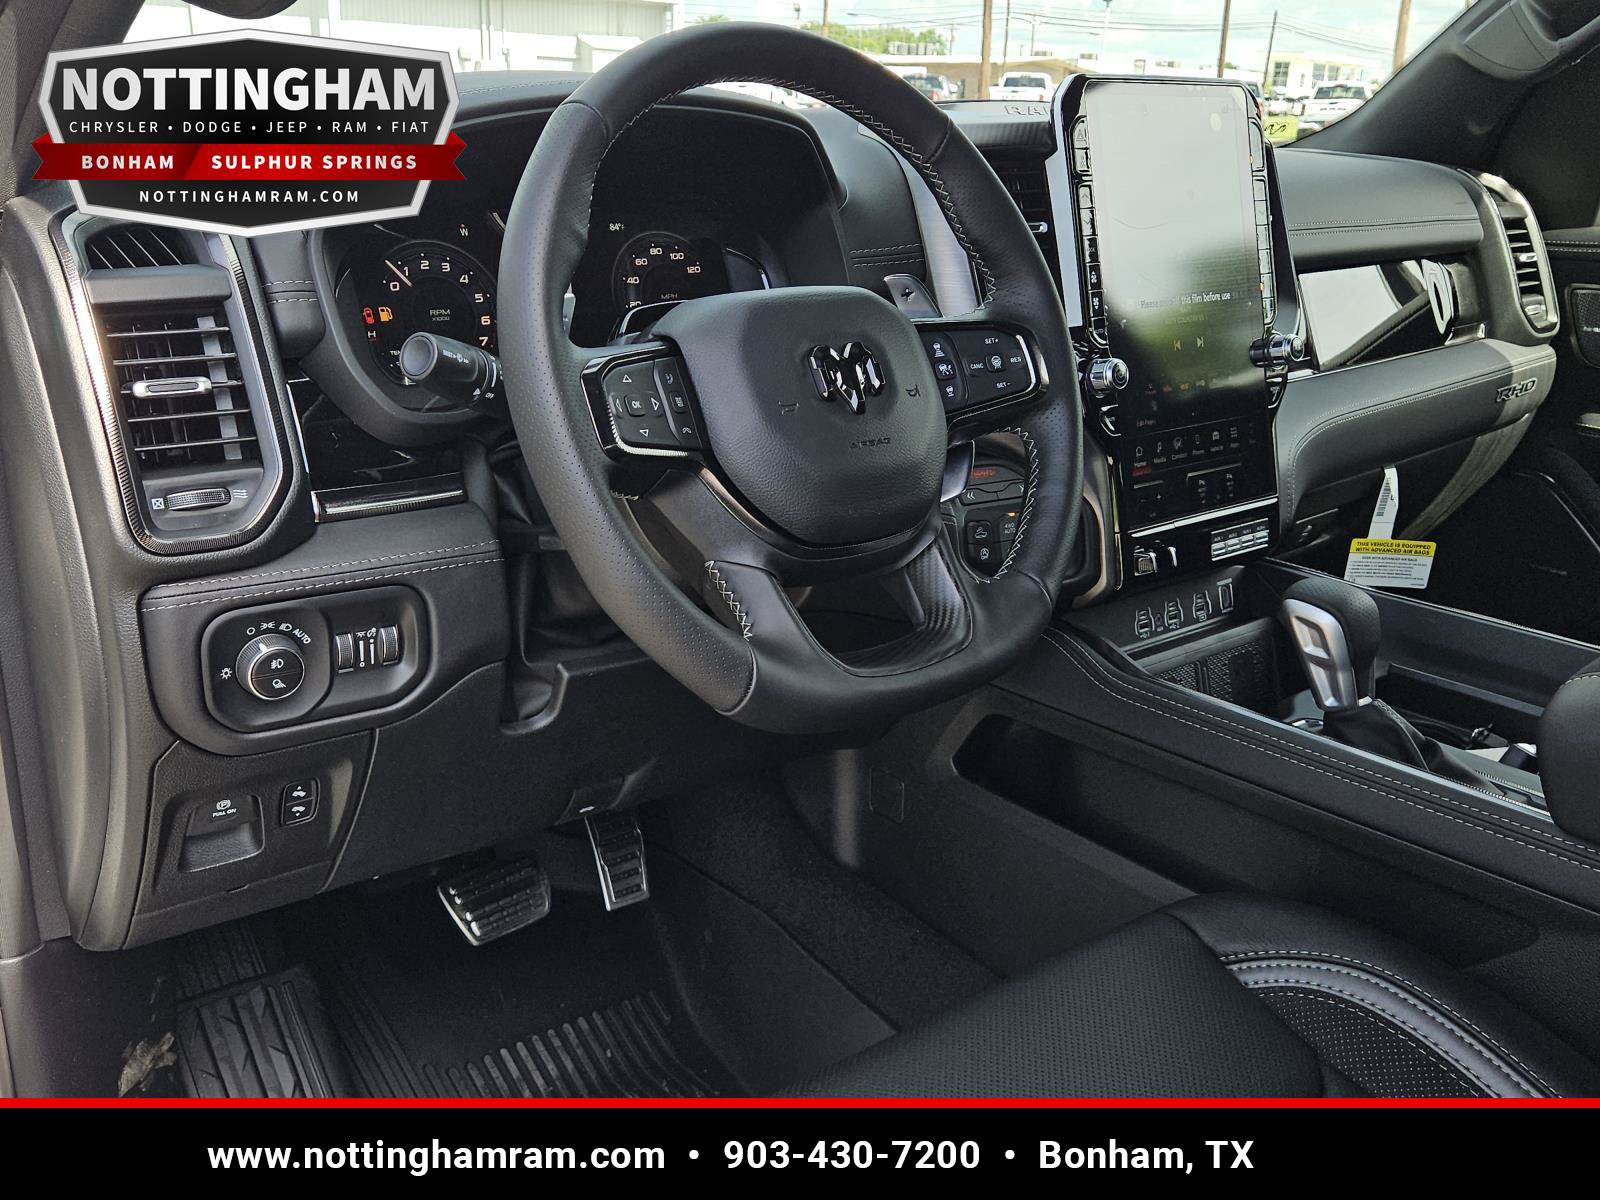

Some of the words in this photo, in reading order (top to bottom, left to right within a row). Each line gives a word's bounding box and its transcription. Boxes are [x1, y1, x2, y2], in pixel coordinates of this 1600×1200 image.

[459, 228, 469, 236] W
[650, 247, 662, 255] 80
[420, 260, 430, 270] 2
[635, 258, 648, 266] 60
[403, 266, 409, 276] 1
[442, 262, 450, 272] 3
[687, 266, 701, 274] 120
[460, 274, 469, 284] 4
[627, 276, 640, 284] 40
[390, 282, 400, 291] 0
[475, 293, 484, 302] 5
[1203, 292, 1221, 302] before
[429, 308, 451, 316] RPM
[481, 315, 491, 325] 6
[479, 336, 489, 346] 7
[631, 400, 642, 408] OK
[292, 628, 312, 644] AUTO
